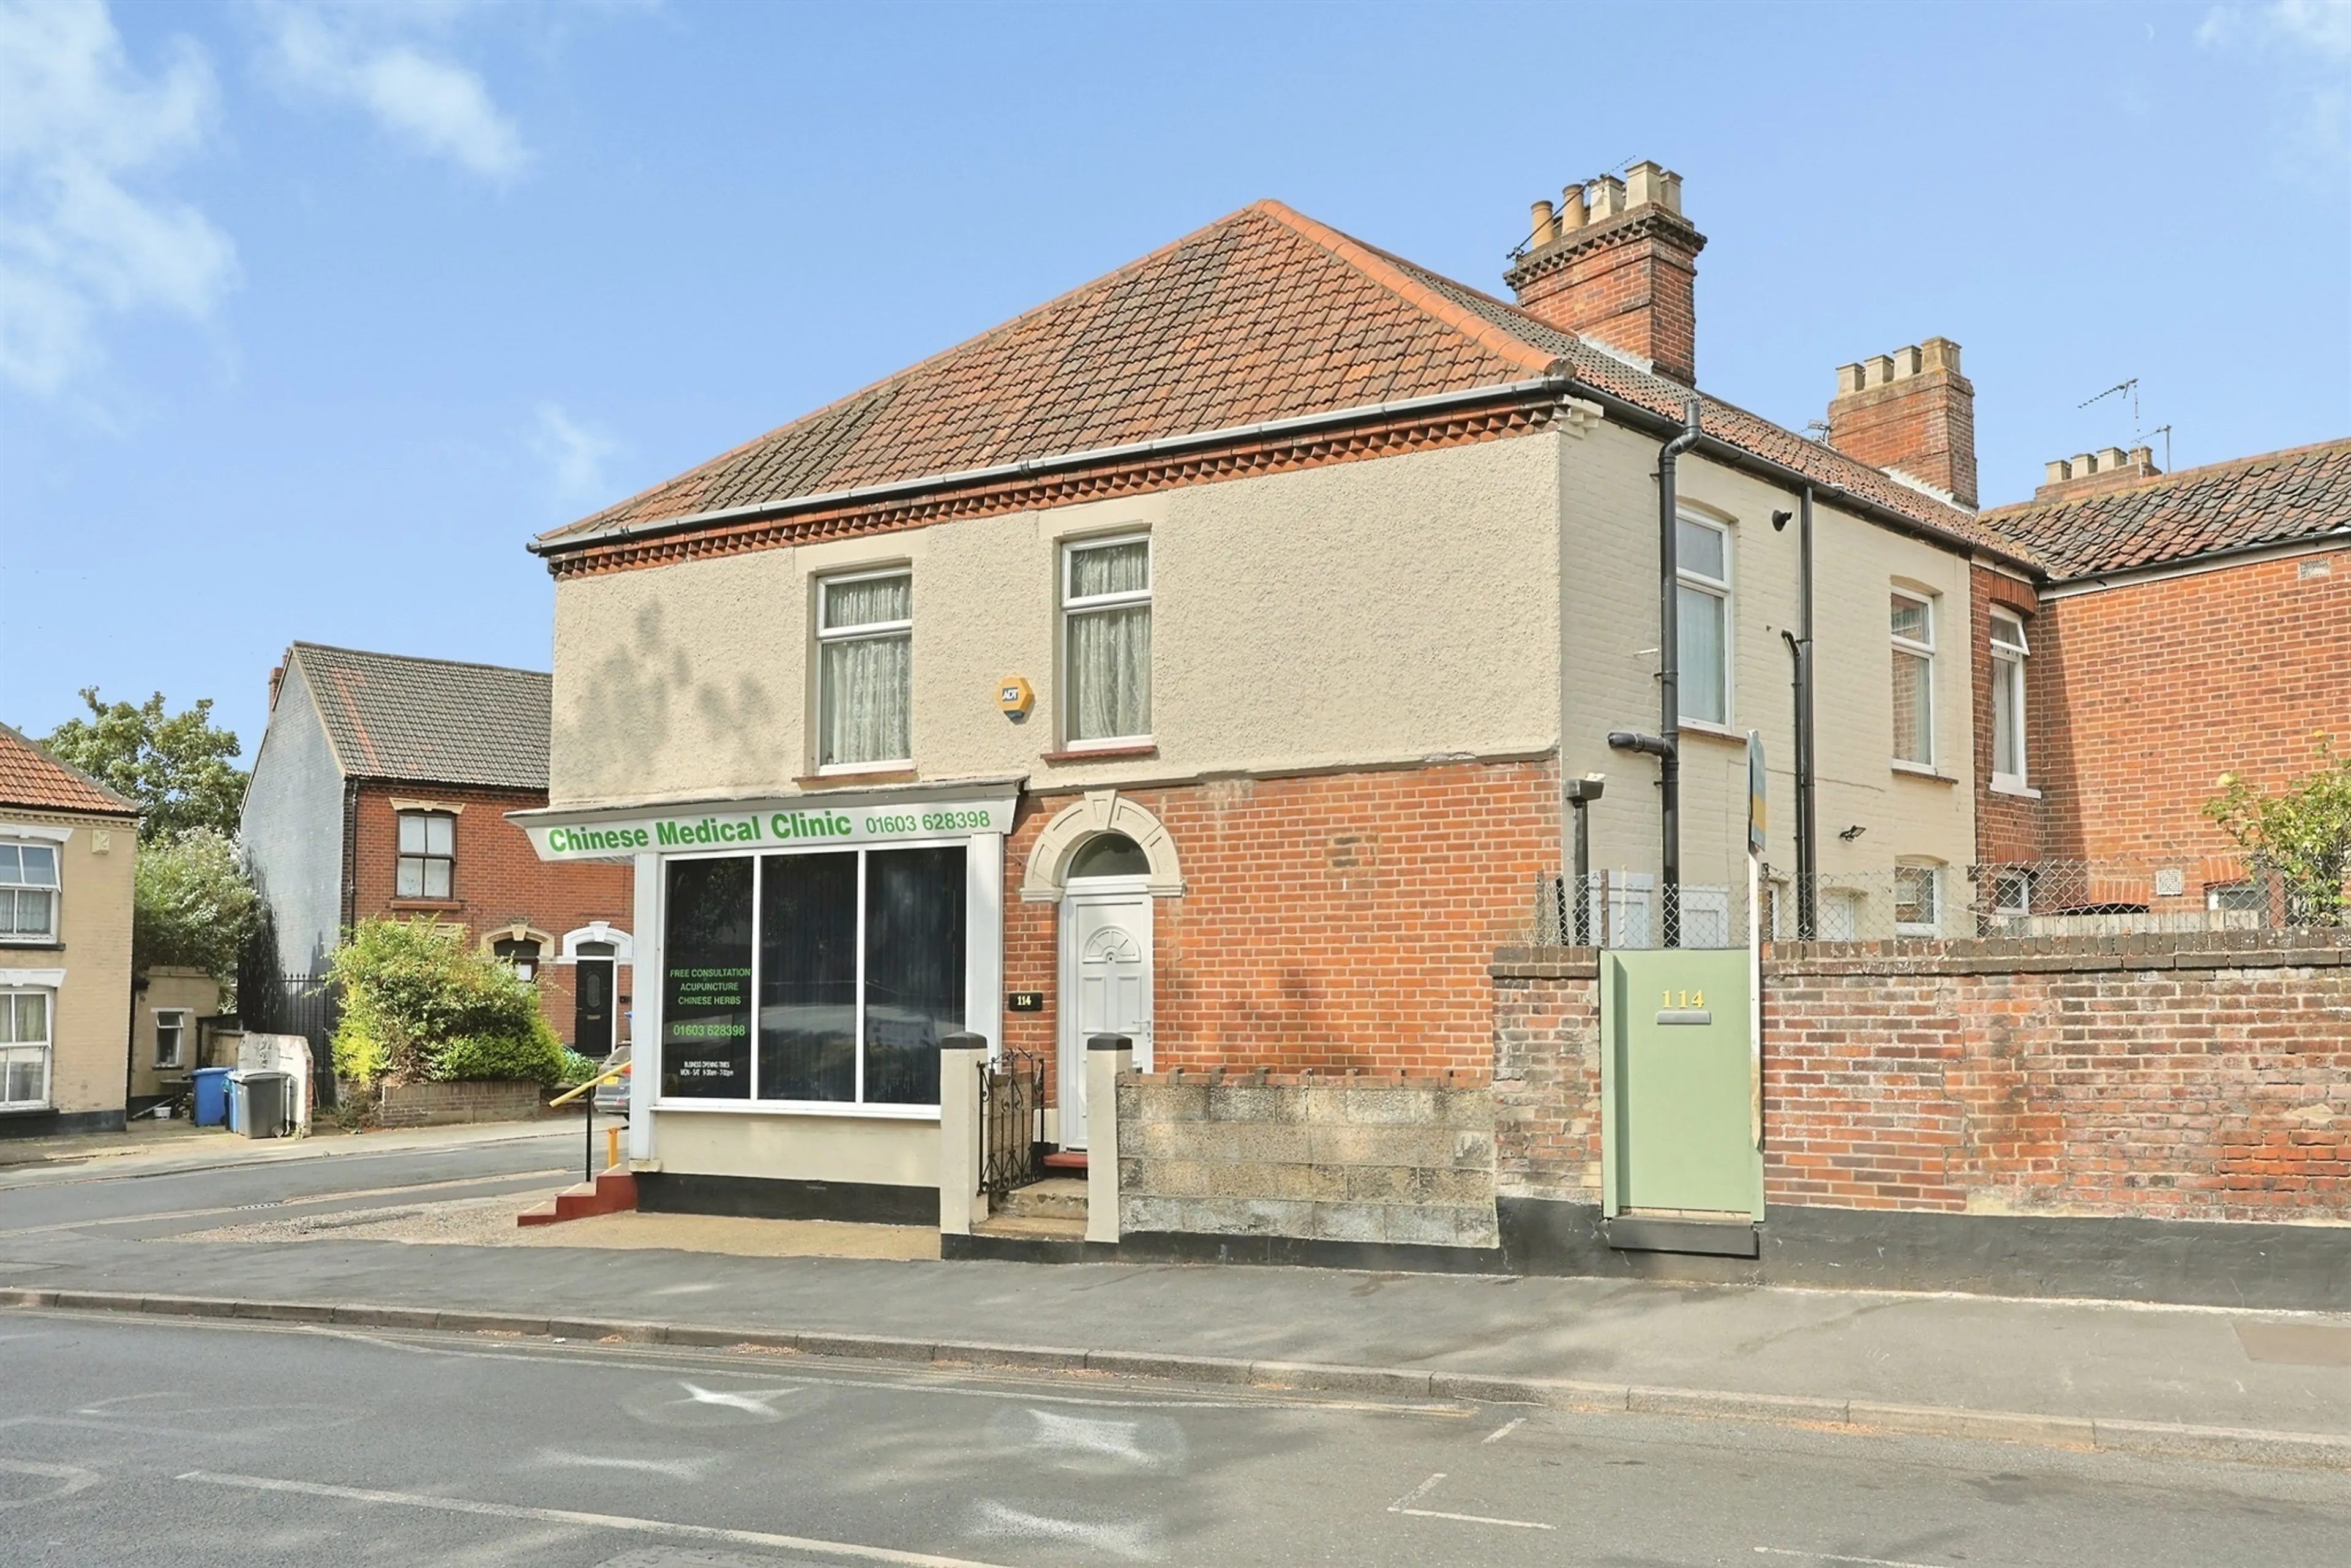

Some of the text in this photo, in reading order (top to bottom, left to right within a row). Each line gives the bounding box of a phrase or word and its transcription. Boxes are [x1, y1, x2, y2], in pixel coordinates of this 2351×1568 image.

[1002, 689, 1018, 700] ADT
[549, 811, 991, 853] Chinese Medical Clinic 01603 628398
[670, 968, 751, 977] FREE CONSULTATION
[680, 982, 739, 991] ACUPUNCTURE
[678, 996, 741, 1005] CHINESE HERBS
[1017, 995, 1032, 1005] 114
[1662, 989, 1704, 1009] 114
[673, 1024, 746, 1036] 01603 628398
